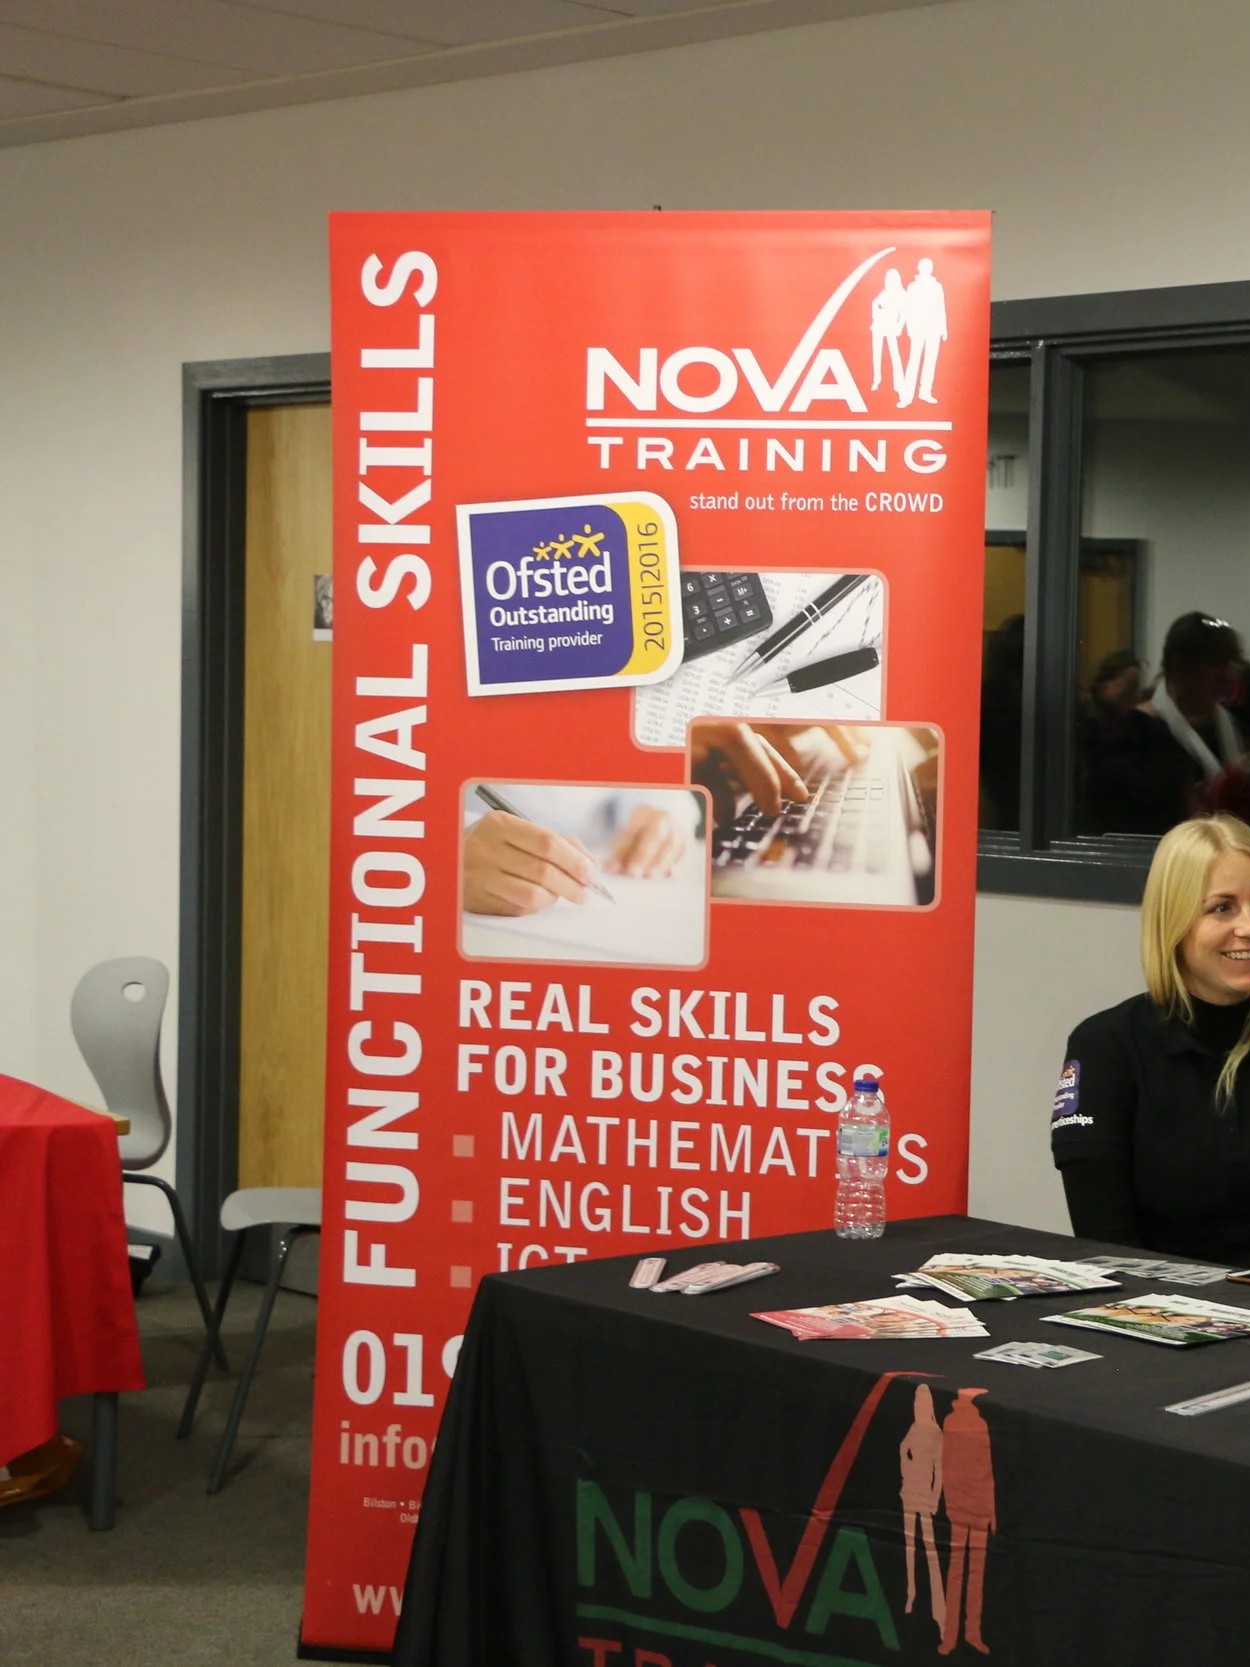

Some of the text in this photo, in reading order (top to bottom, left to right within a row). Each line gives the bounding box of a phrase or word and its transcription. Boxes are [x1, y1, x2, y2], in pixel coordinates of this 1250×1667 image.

[586, 347, 868, 412] NOVA
[588, 437, 947, 473] TRAINING
[690, 492, 943, 513] stand out from the CROWD
[486, 552, 612, 601] Ofsted
[489, 601, 614, 629] Outstanding
[491, 631, 603, 653] Training provider
[344, 250, 438, 1287] FUNCTIONAL SKILLS
[459, 980, 840, 1047] REAL SKILLS
[458, 1044, 567, 1097] FOR
[500, 1112, 929, 1185] MATHEMATS
[500, 1178, 752, 1240] ENGLISH
[363, 1497, 397, 1509] Bilston
[577, 1479, 900, 1651] NOVA
